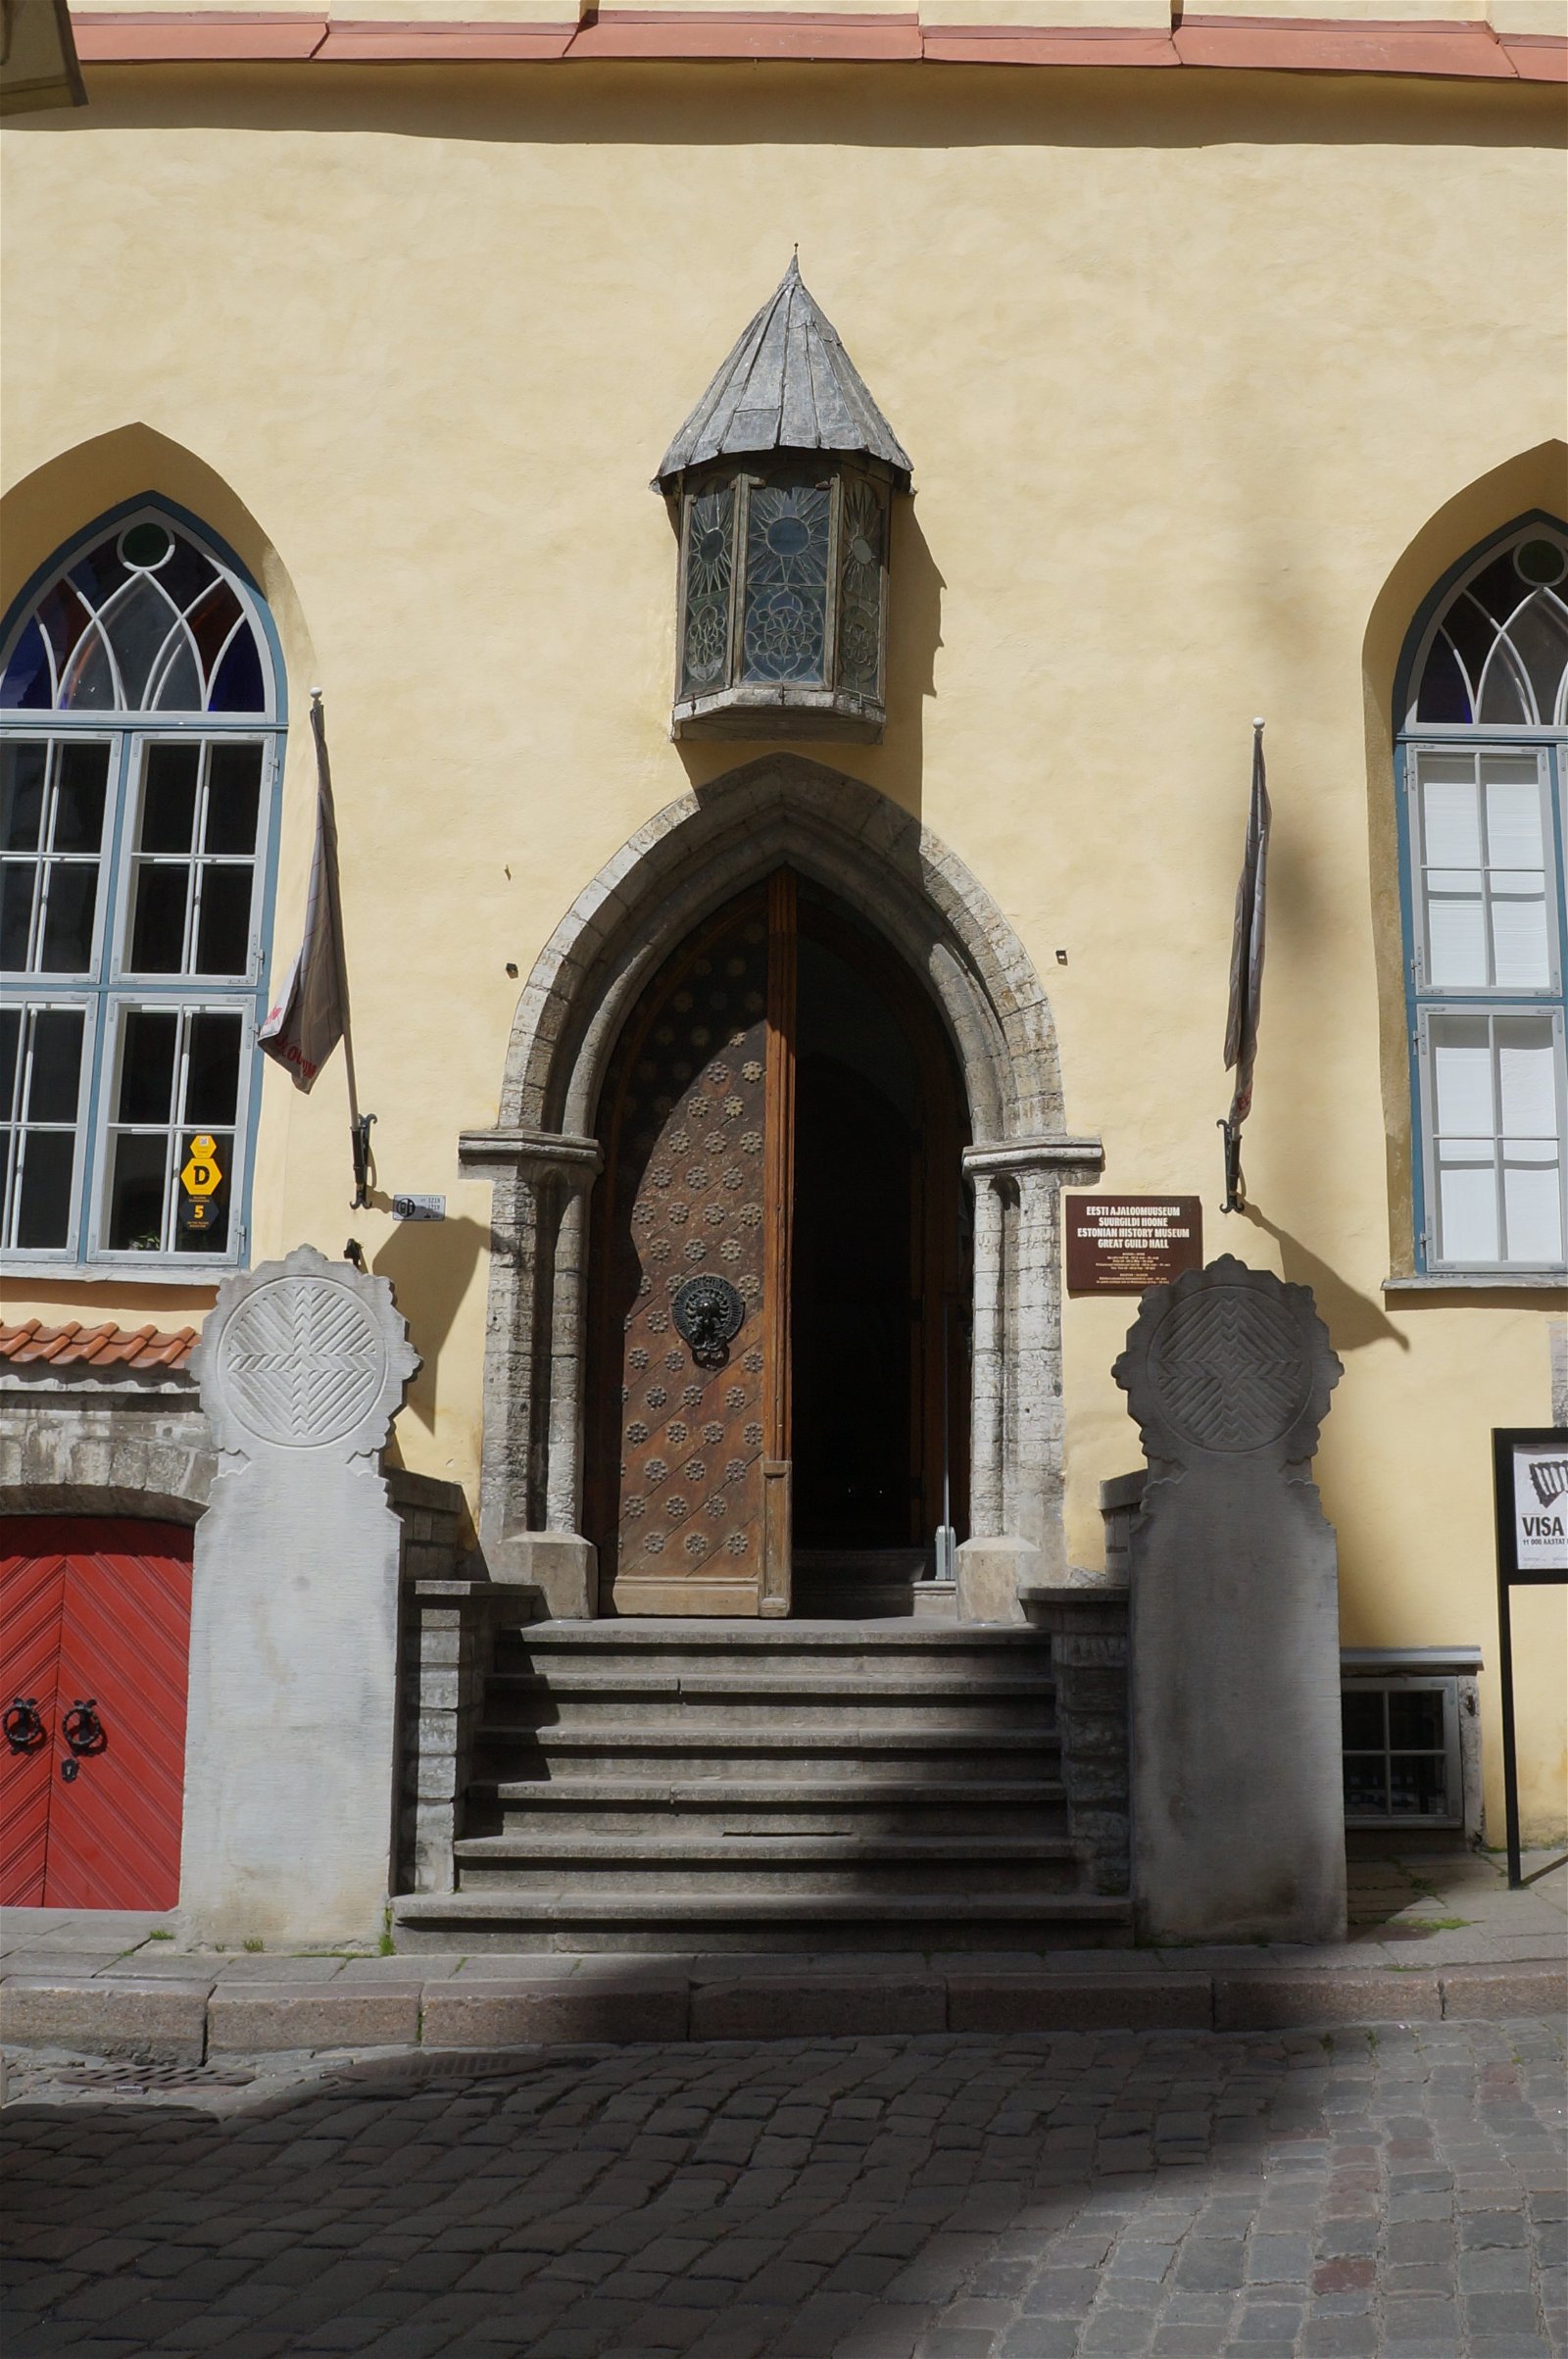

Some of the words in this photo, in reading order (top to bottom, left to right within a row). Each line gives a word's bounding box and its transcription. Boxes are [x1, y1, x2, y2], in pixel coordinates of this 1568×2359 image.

[193, 1165, 210, 1185] D
[194, 1204, 204, 1218] 5
[1086, 1206, 1108, 1216] EESTI
[1110, 1206, 1180, 1216] AJALOOMUUSEUM
[1099, 1217, 1140, 1227] SUURGILDI
[1142, 1217, 1168, 1227] HOONE
[1077, 1228, 1117, 1238] ESTONIAN
[1119, 1228, 1153, 1238] HISTORY
[1154, 1228, 1190, 1238] MUSEUM
[1098, 1239, 1123, 1249] GREAT
[1124, 1239, 1148, 1249] GUILD
[1150, 1239, 1169, 1249] HALL
[1522, 1517, 1565, 1536] VISA
